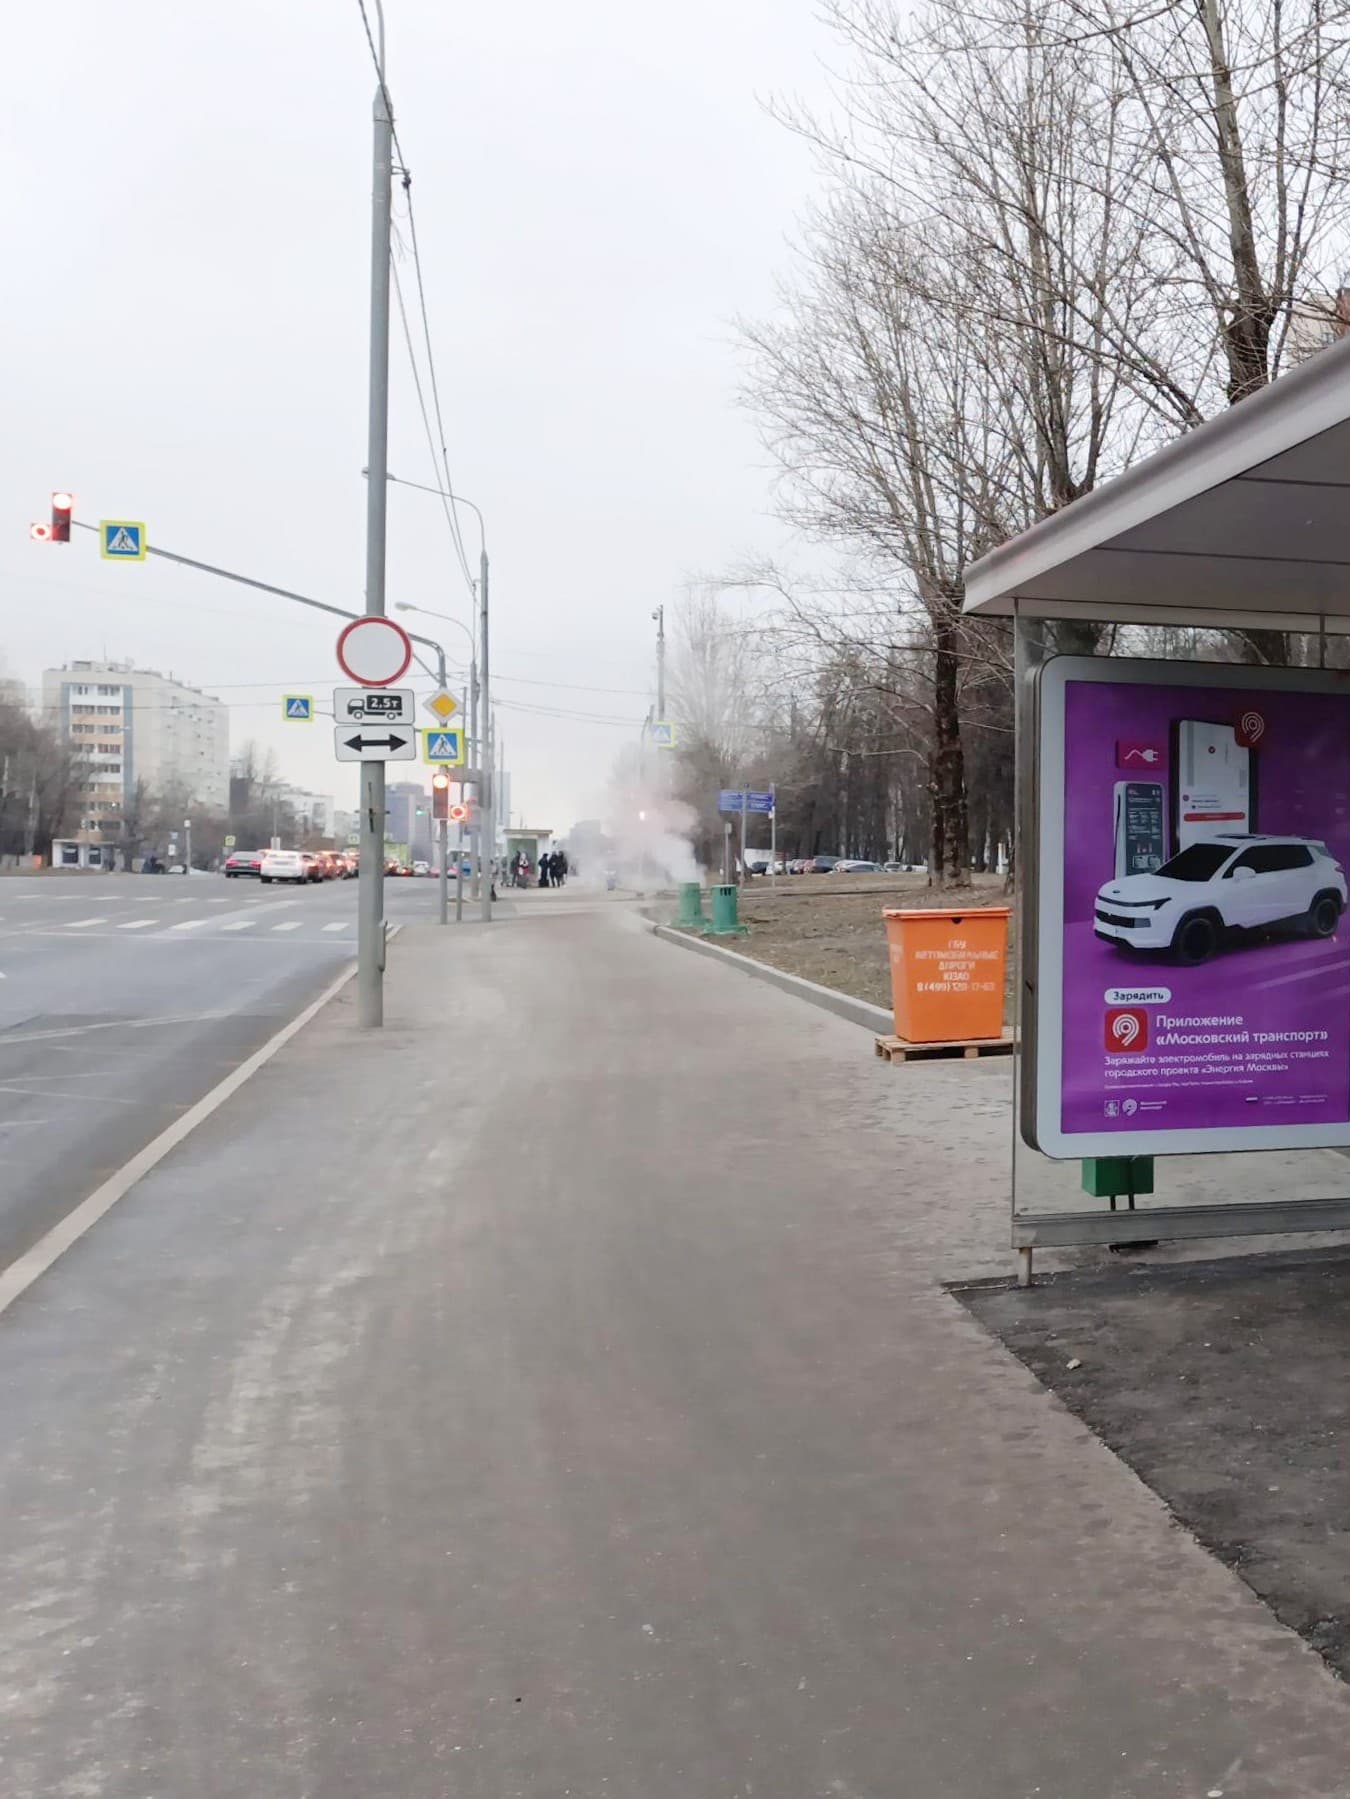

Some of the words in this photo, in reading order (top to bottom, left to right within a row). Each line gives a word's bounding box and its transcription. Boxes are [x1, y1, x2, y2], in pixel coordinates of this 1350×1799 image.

[1113, 991, 1164, 1002] Зарядить
[1156, 1015, 1243, 1029] Приложение
[1156, 1031, 1249, 1046] «Московский
[1253, 1030, 1328, 1044] транспорт»
[1104, 1054, 1155, 1067] Заряжайте
[1158, 1051, 1231, 1065] электромобиль
[1104, 1067, 1158, 1079] городского
[1160, 1066, 1199, 1077] проекта
